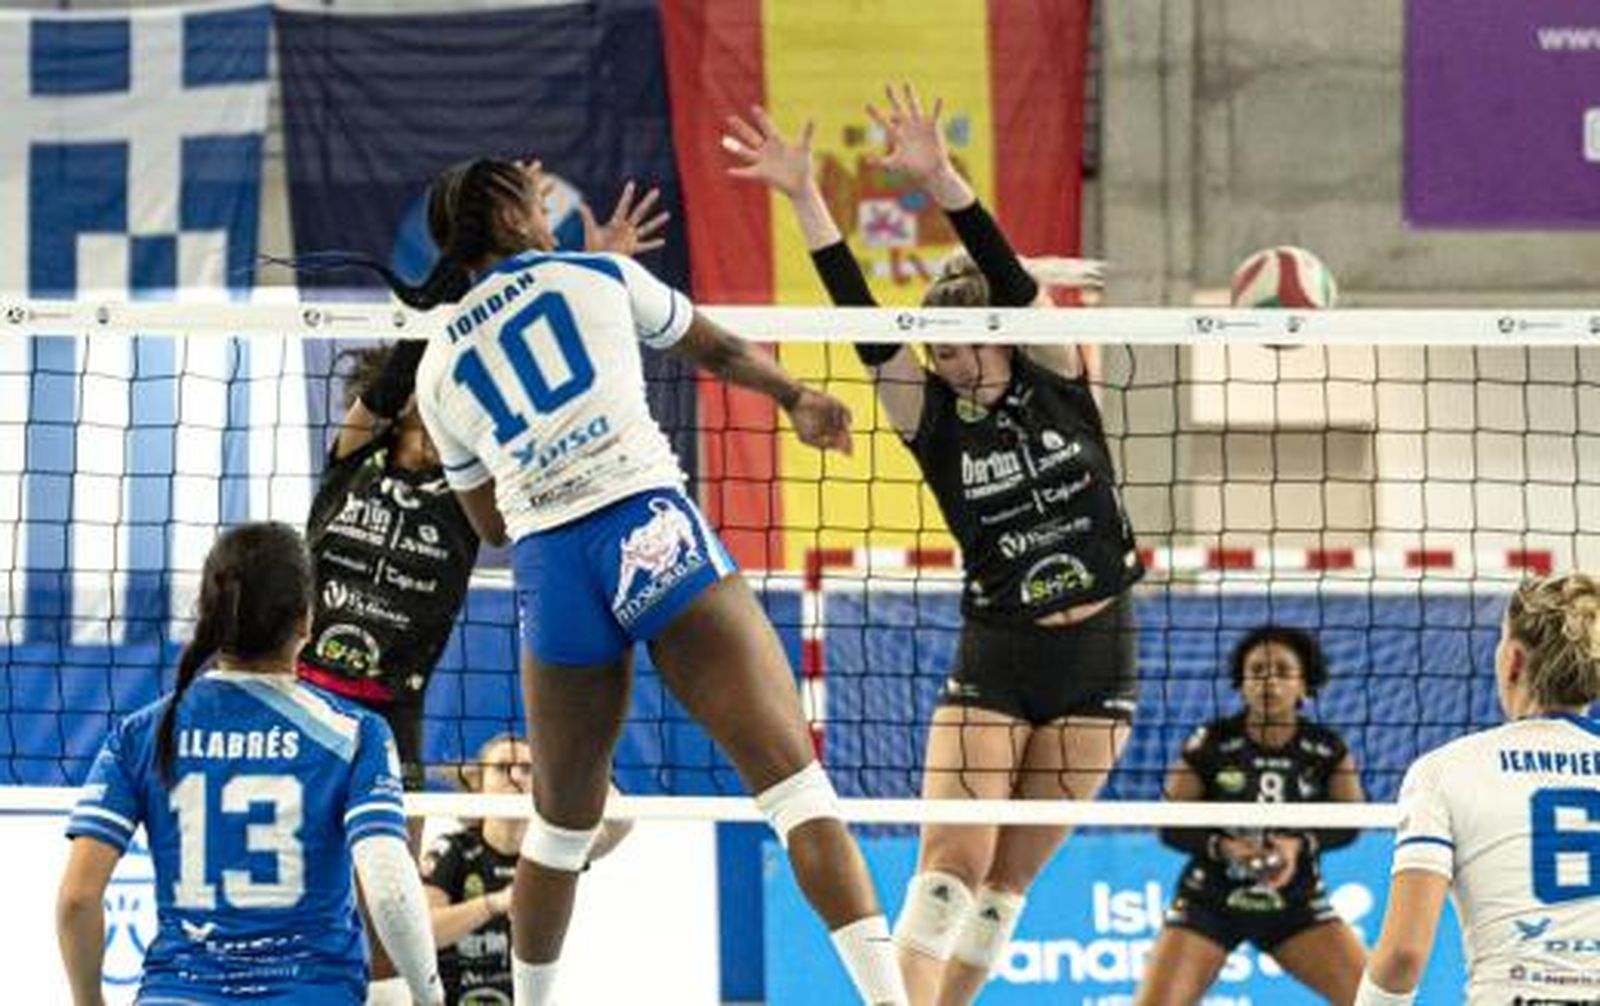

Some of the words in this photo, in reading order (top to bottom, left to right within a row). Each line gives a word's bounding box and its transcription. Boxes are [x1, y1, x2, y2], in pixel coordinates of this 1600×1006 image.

[446, 270, 535, 344] JORDAN
[453, 291, 595, 446] 10
[179, 725, 299, 758] LLABRÉS
[168, 772, 306, 910] 13
[1530, 787, 1600, 905] 6
[1092, 882, 1164, 934] Isl
